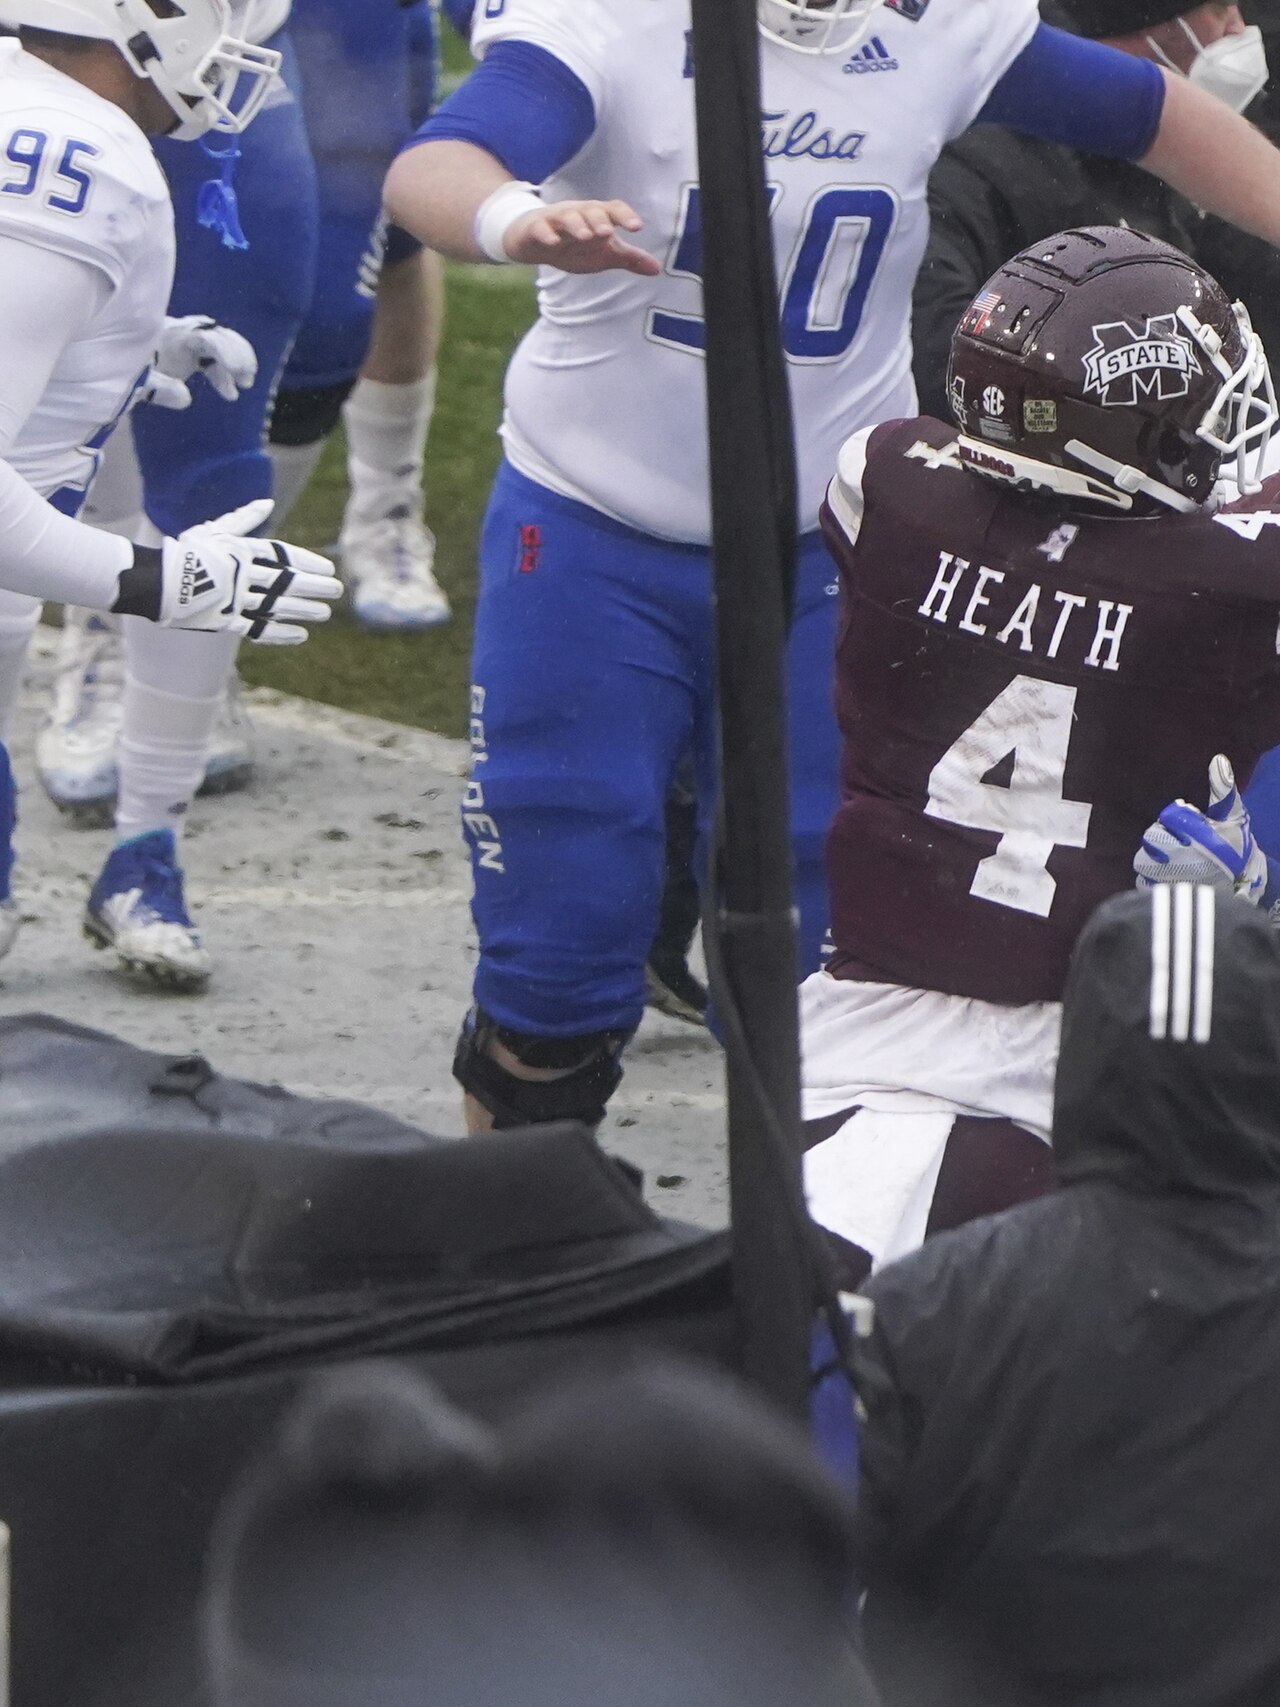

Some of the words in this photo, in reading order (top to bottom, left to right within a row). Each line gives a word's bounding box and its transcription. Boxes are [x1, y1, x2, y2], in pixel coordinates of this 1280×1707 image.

[842, 58, 899, 75] adidas
[1, 127, 100, 215] 95
[1107, 344, 1181, 375] STATE
[982, 386, 1006, 416] SEC
[178, 552, 195, 605] adidas
[918, 550, 1134, 671] HEATH
[923, 674, 1093, 917] 4
